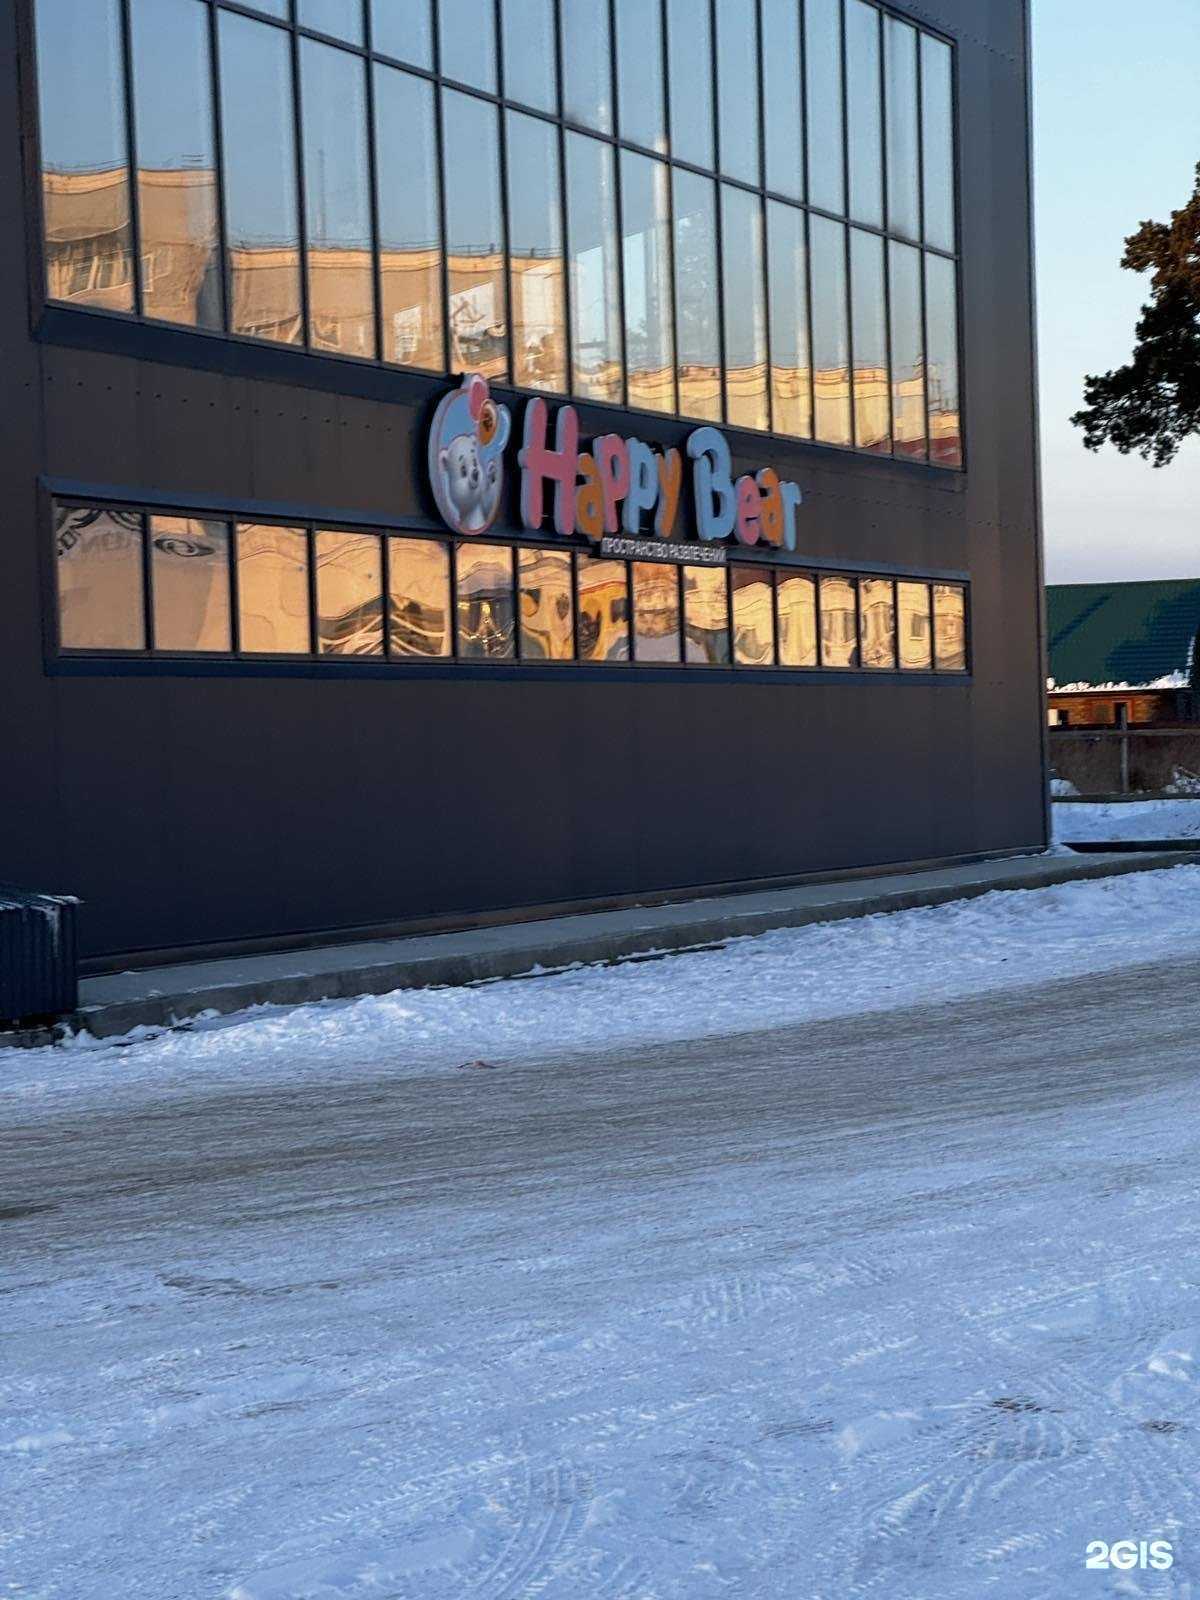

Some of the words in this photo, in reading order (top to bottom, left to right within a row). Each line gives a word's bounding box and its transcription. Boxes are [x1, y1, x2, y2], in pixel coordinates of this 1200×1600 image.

[518, 397, 682, 542] Happy
[687, 426, 802, 551] Bear
[601, 537, 668, 558] ПРОСТРАНСТВО
